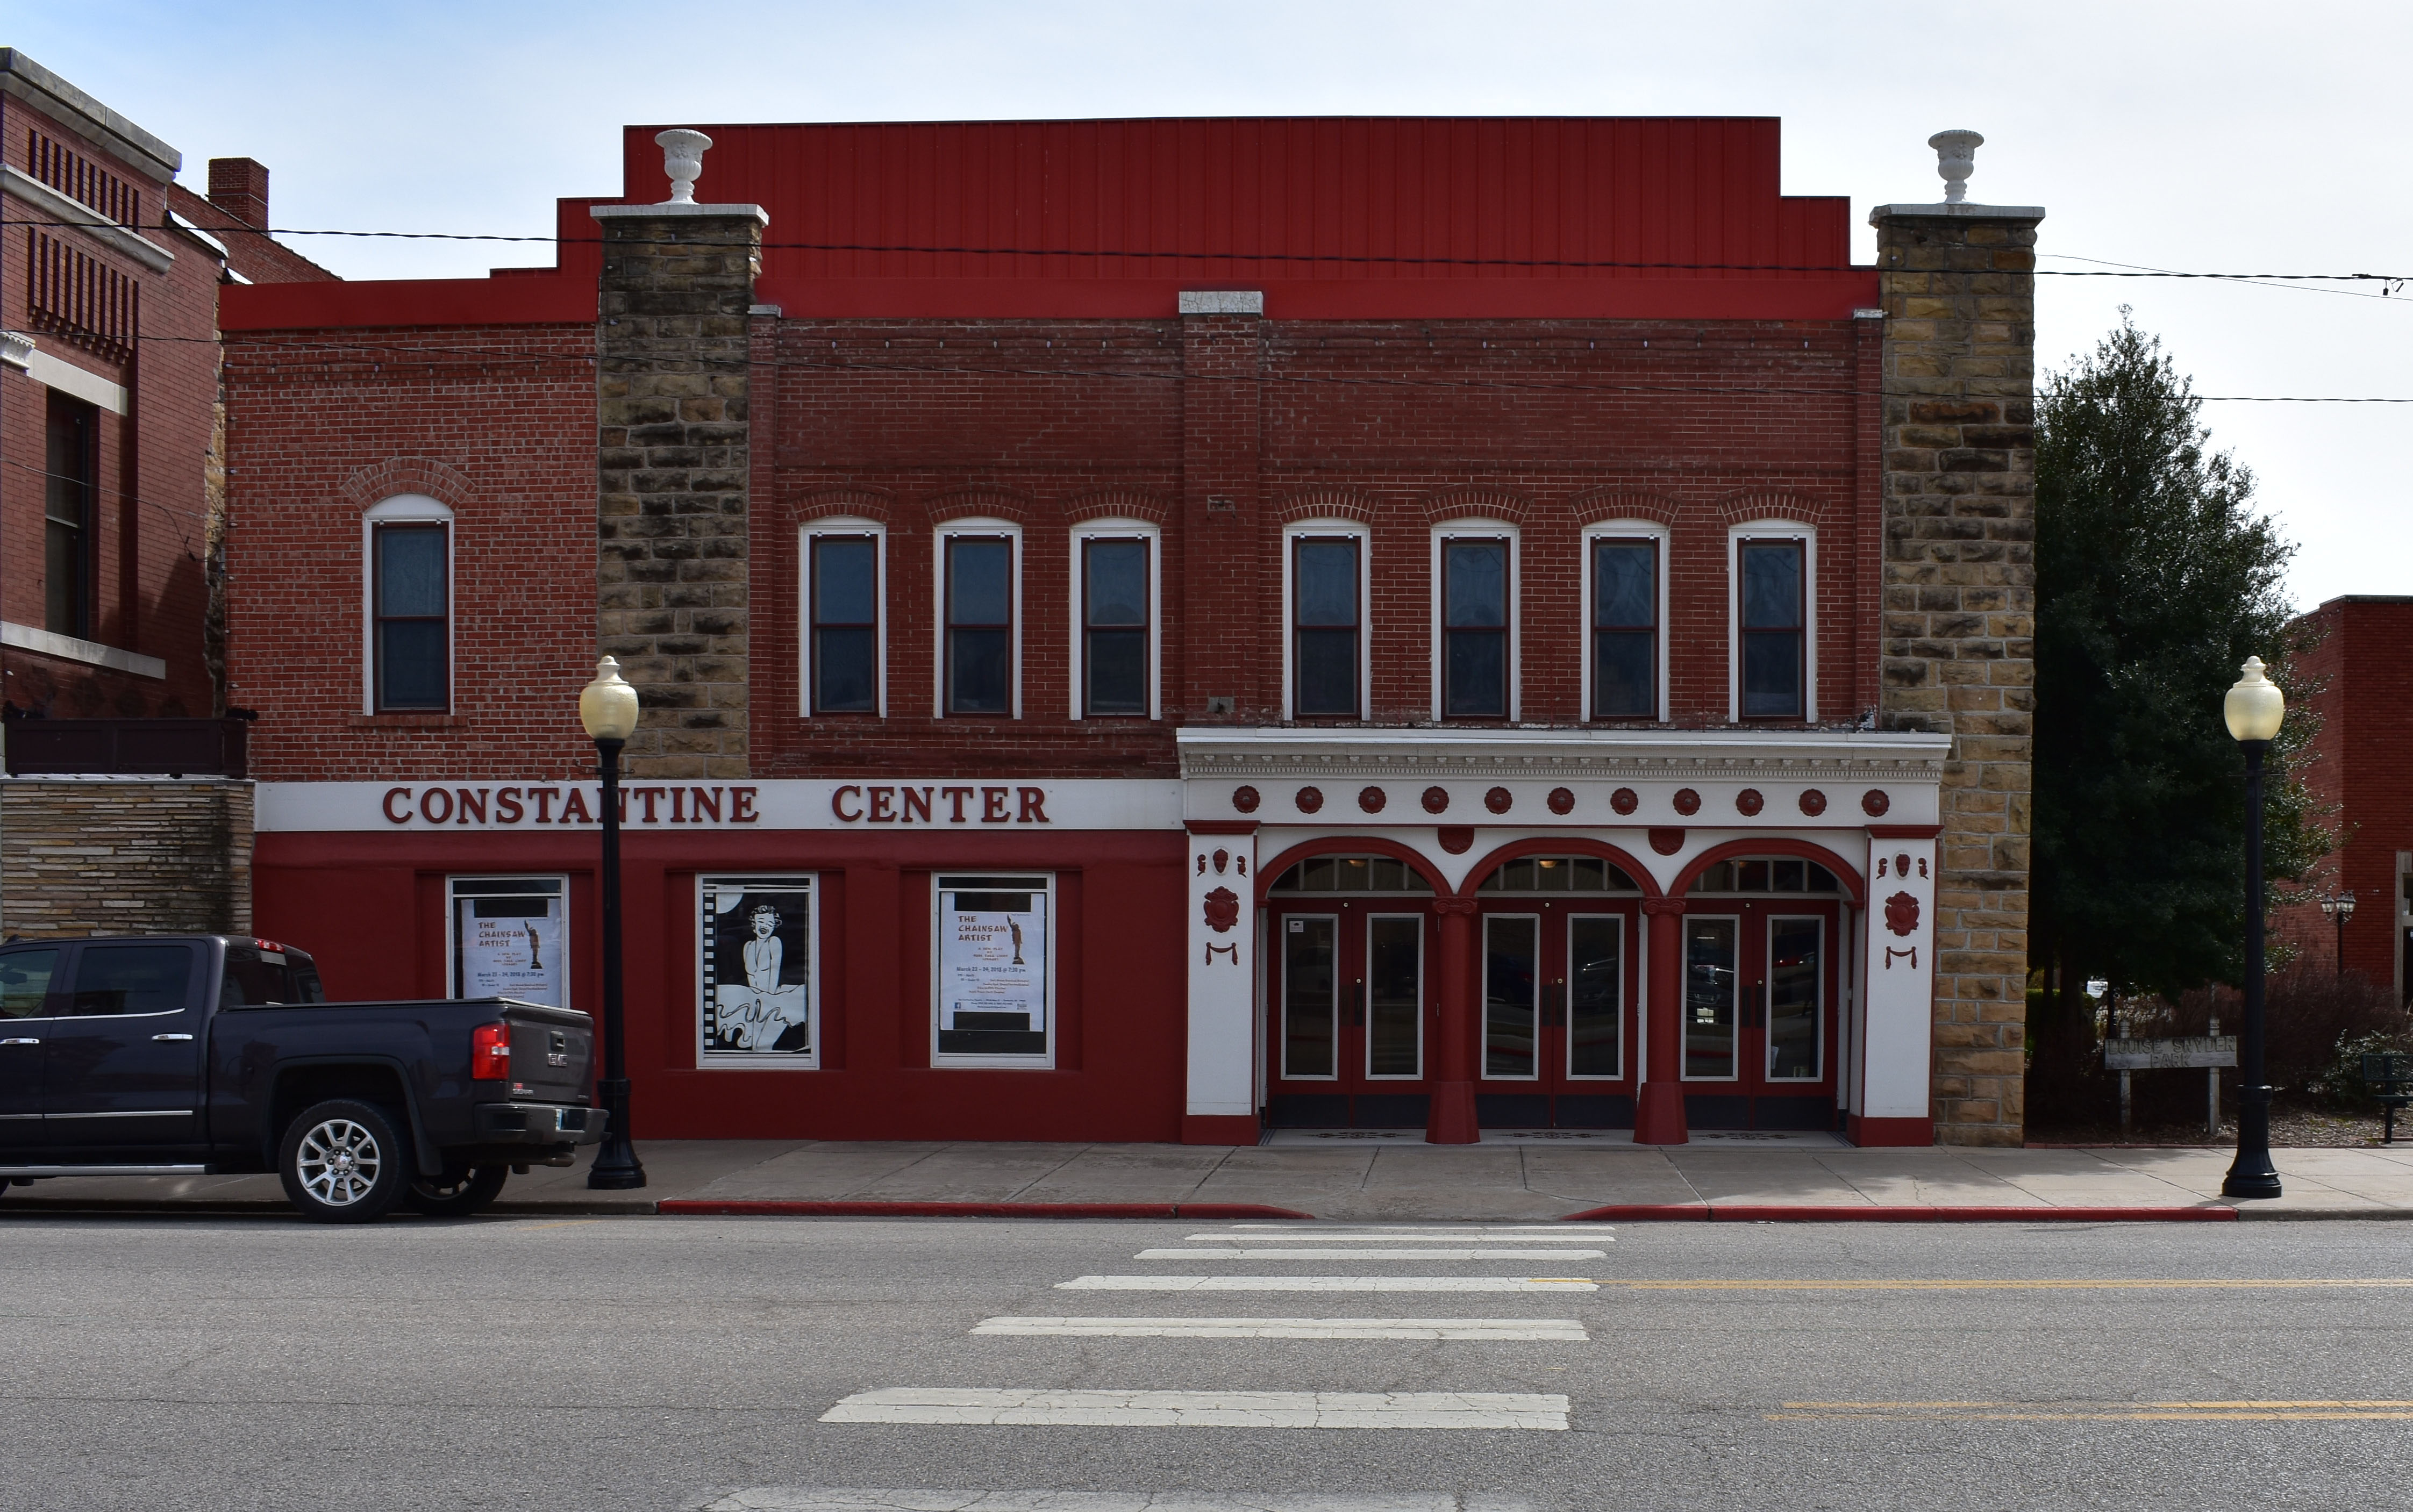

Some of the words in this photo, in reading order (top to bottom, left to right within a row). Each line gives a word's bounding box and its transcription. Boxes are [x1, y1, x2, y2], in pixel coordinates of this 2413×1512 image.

[382, 787, 759, 823] CONSTANTINE
[832, 785, 1050, 822] CENTER
[2108, 1039, 2164, 1055] LOUISE
[2172, 1036, 2236, 1054] SNYDER
[2151, 1053, 2191, 1068] PARK
